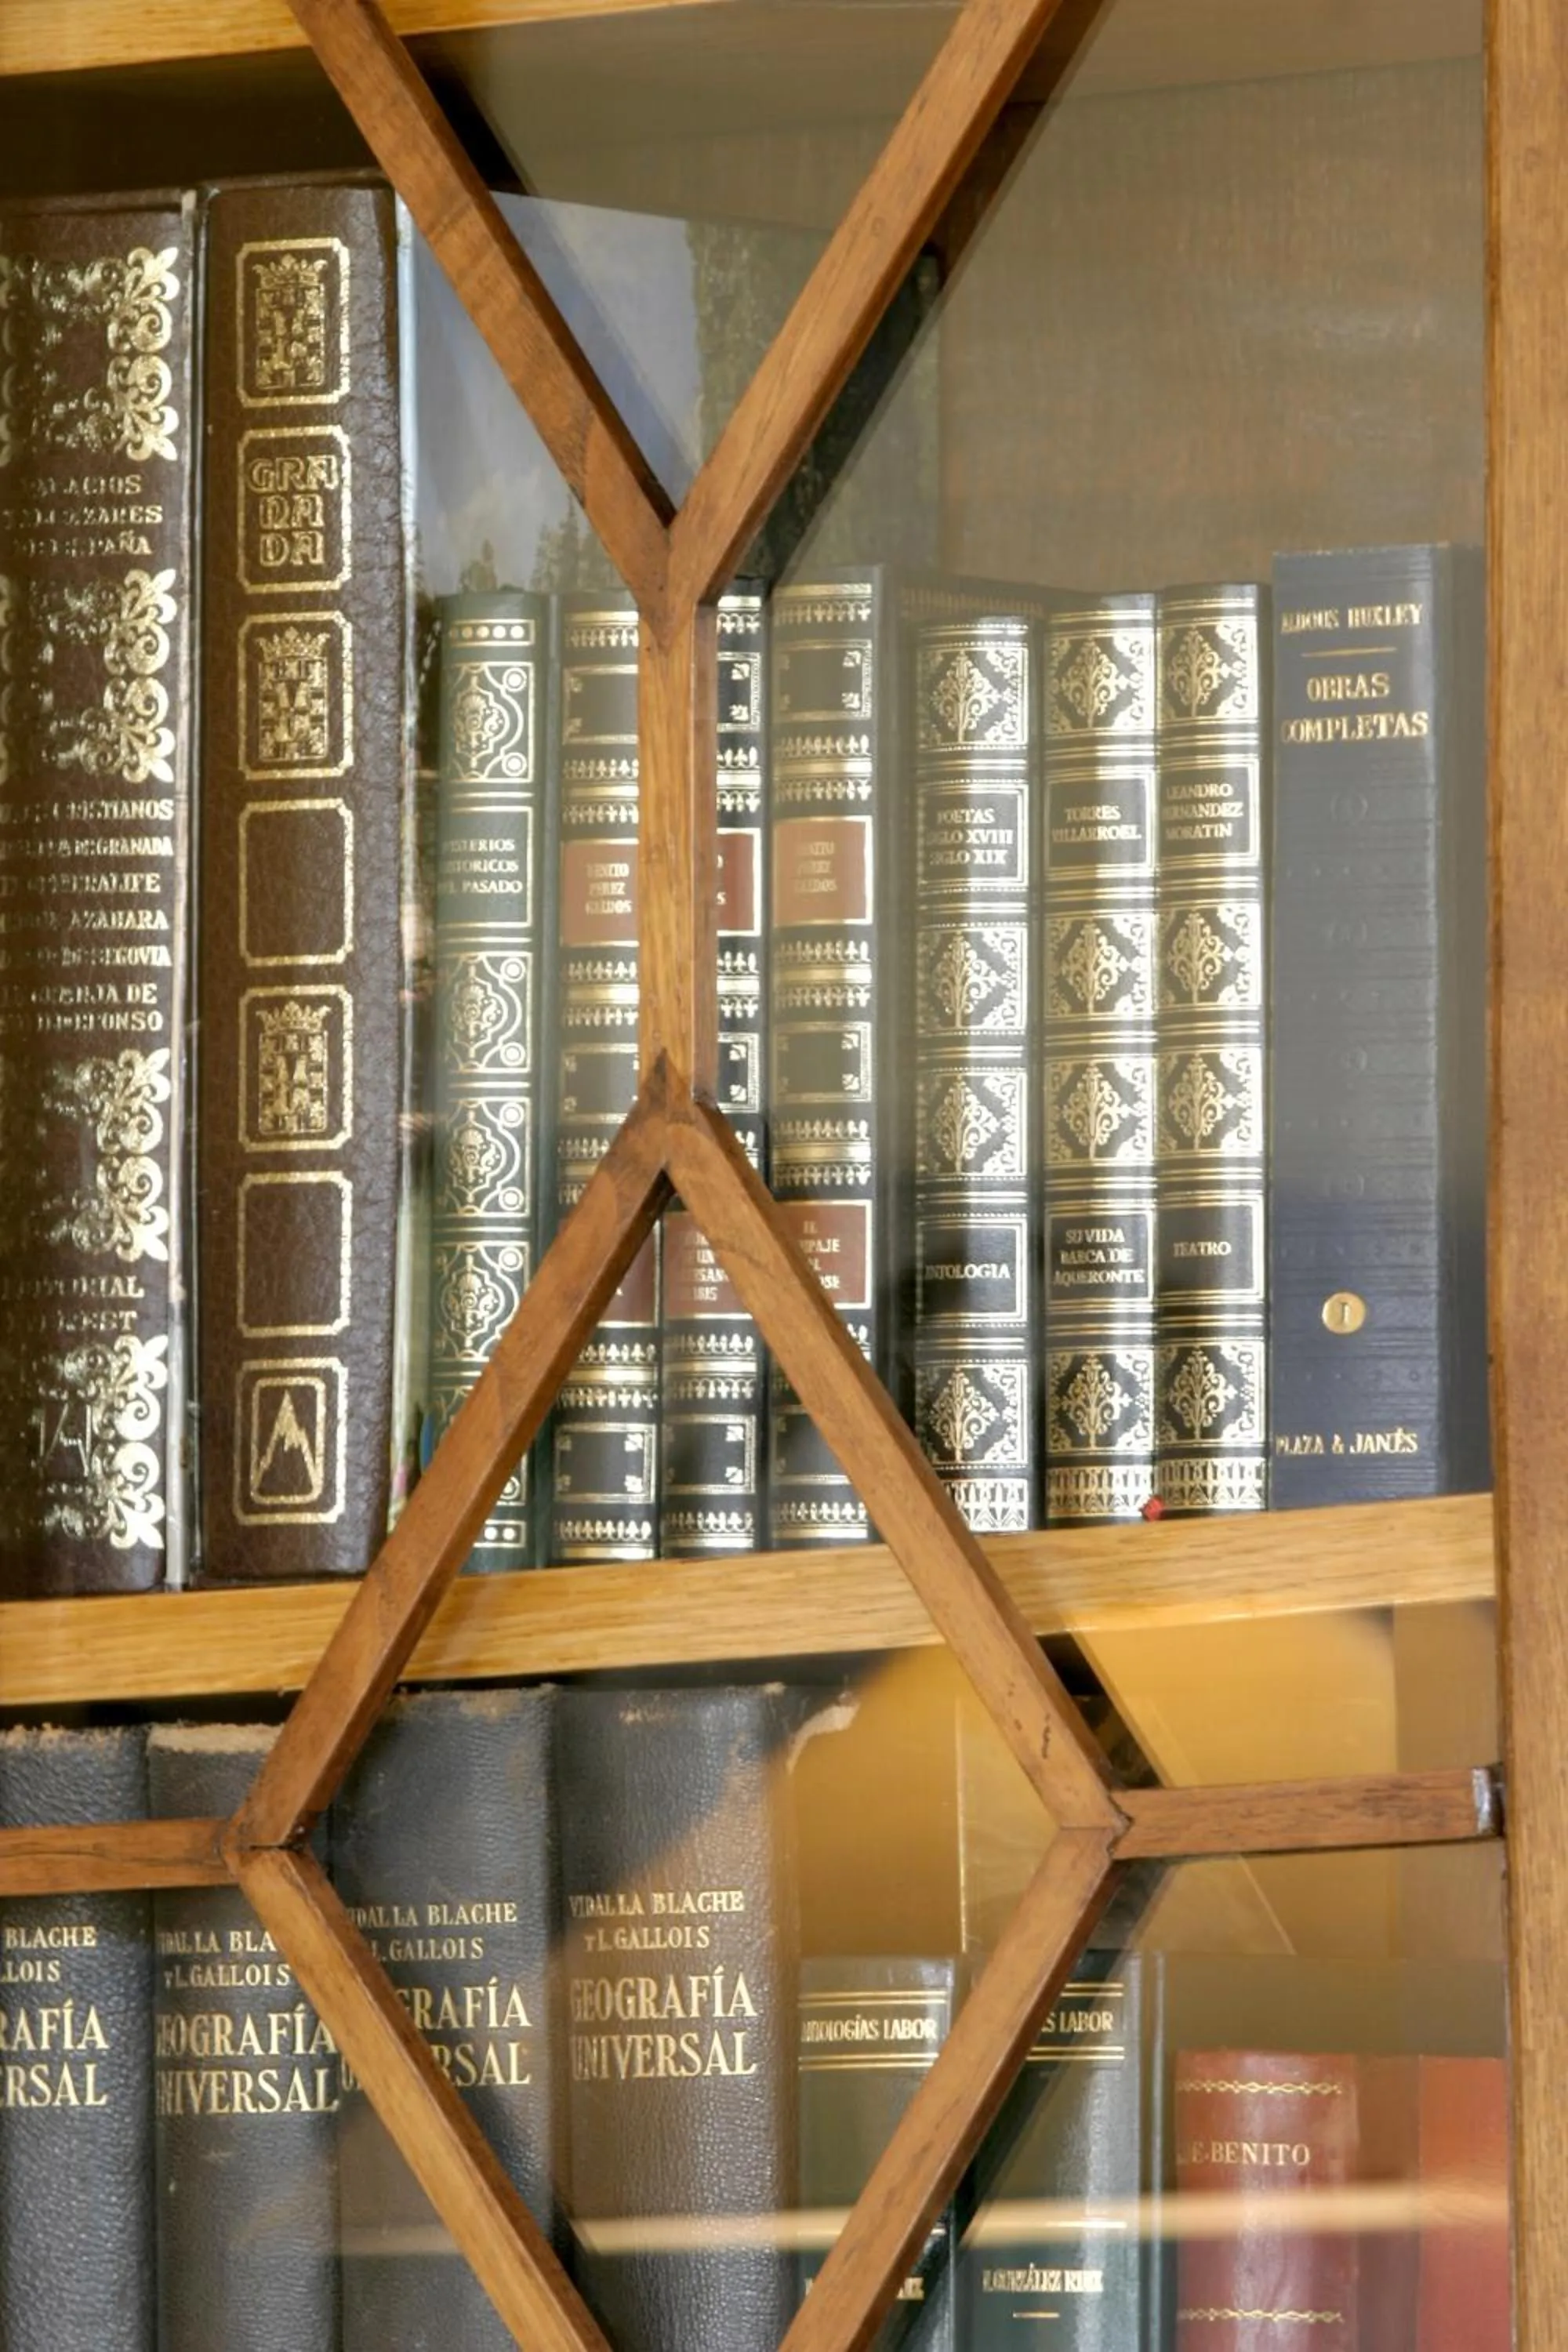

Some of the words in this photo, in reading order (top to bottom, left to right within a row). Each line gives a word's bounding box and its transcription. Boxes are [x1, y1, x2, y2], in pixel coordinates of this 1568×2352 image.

[1347, 603, 1424, 629] HUXLEY
[1306, 672, 1390, 702] OBRAS
[1280, 711, 1429, 743] COMPLETAS
[1166, 782, 1234, 800] LEANDRO
[935, 806, 996, 824] POETAS
[1064, 804, 1122, 822] TORRES
[965, 828, 1014, 845] XVIII
[971, 848, 1010, 866] XIX
[462, 879, 524, 894] PASADO
[126, 982, 158, 1005] DE
[1084, 1228, 1126, 1243] VIDA
[1107, 1247, 1135, 1265] DE
[1172, 1241, 1232, 1258] TEATRO
[1275, 1433, 1325, 1456] PLAZA
[1331, 1433, 1345, 1455] &
[347, 1904, 390, 1929] IDAL
[391, 1904, 419, 1928] LA
[428, 1901, 518, 1927] BLACHE
[616, 1892, 646, 1917] LA
[652, 1889, 746, 1915] BLACHE
[4, 1925, 99, 1950] BLACHE
[194, 1929, 221, 1954] LA
[228, 1929, 278, 1954] BLA
[389, 1936, 485, 1962] GALLOIS
[612, 1924, 712, 1951] GALLOIS
[0, 1958, 62, 1984] LOIS
[189, 1962, 292, 1988] GALLOIS
[569, 1963, 759, 2023] GEOGRAFÍA
[156, 2002, 338, 2059] EOGRAFÍA
[883, 2017, 937, 2041] LABOR
[1058, 2009, 1114, 2034] LABOR
[569, 2028, 759, 2082] UNIVERSAL
[0, 2060, 111, 2109] RSAL
[156, 2067, 343, 2116] NIVERSAL
